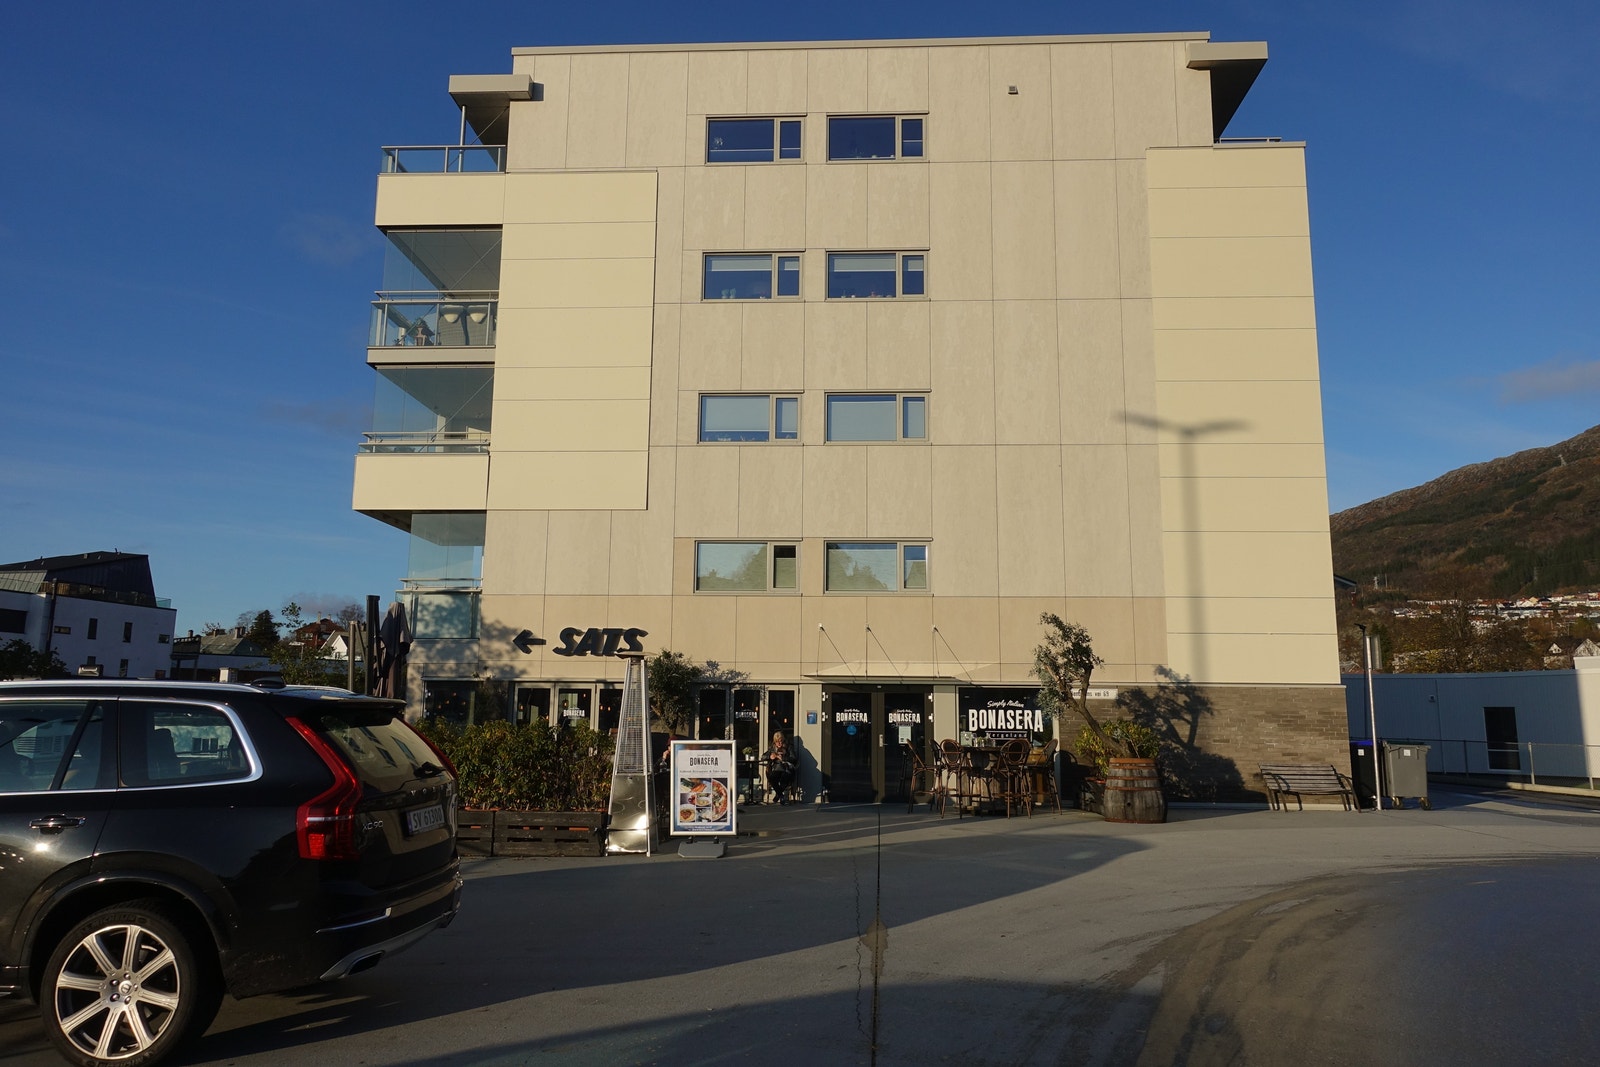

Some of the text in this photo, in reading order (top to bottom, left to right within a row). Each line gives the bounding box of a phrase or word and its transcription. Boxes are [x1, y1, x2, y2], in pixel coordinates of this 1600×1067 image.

[552, 627, 648, 656] SATS
[987, 699, 1024, 708] Simply Italian
[836, 712, 868, 723] BONASERA
[888, 712, 921, 723] BONASERA
[968, 709, 1043, 732] BONASERA
[690, 757, 718, 766] BONASERA
[413, 813, 422, 828] SV
